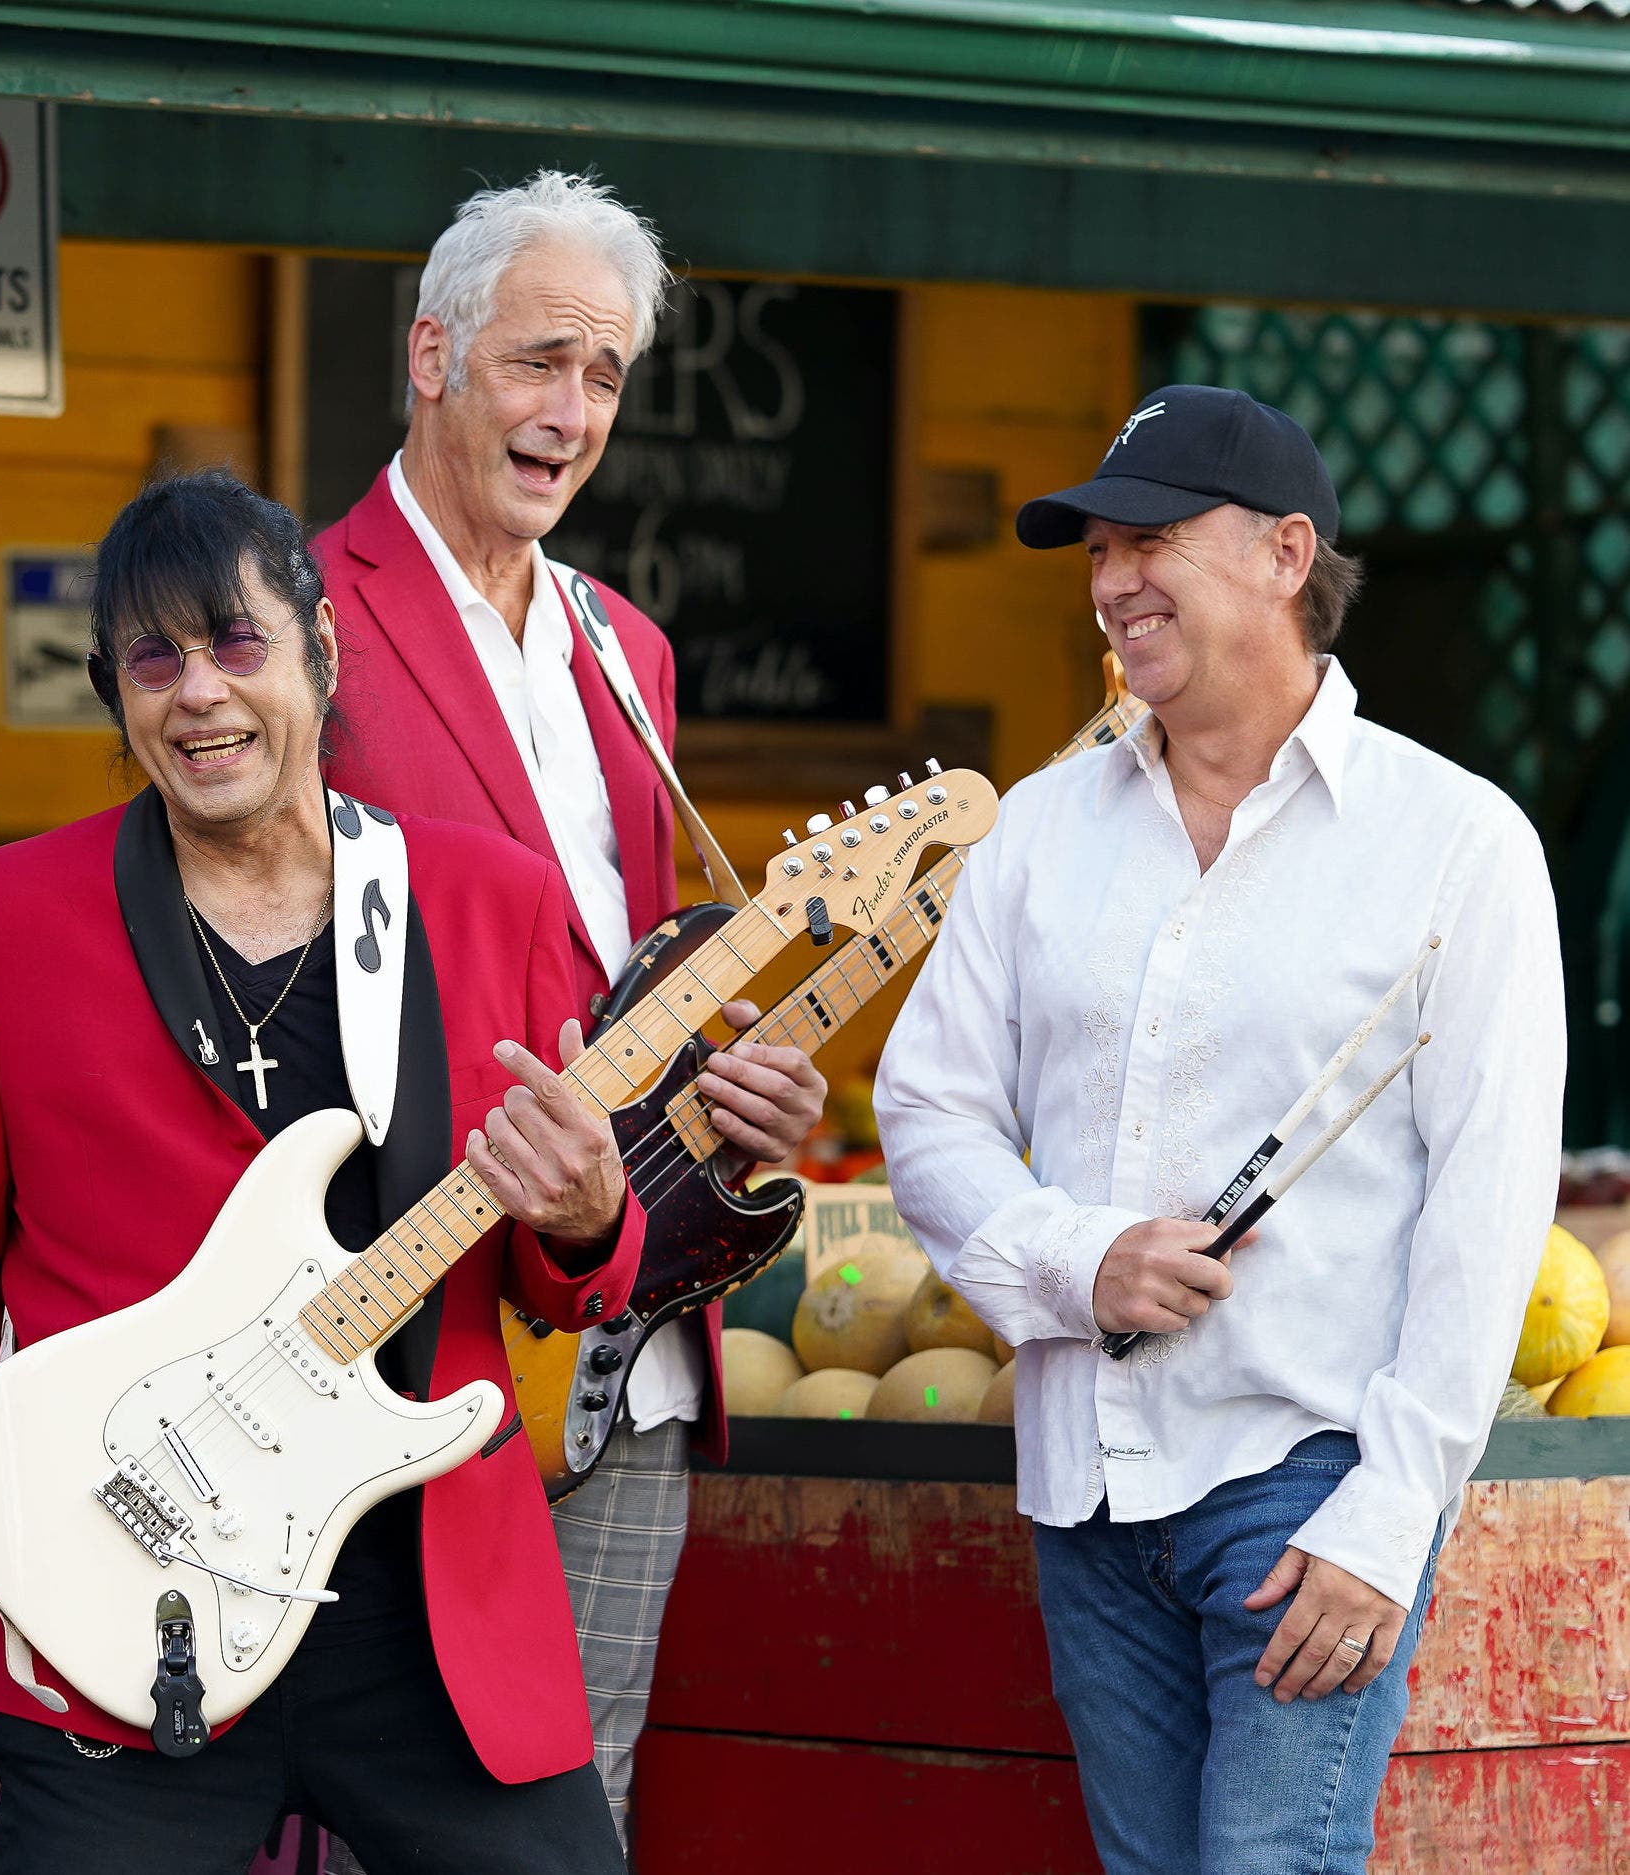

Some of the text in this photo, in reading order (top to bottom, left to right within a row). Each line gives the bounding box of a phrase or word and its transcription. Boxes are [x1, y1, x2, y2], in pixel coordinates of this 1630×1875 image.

[852, 809, 949, 925] Fender STRATOCASTER
[1215, 1153, 1270, 1215] VIC FIRTH
